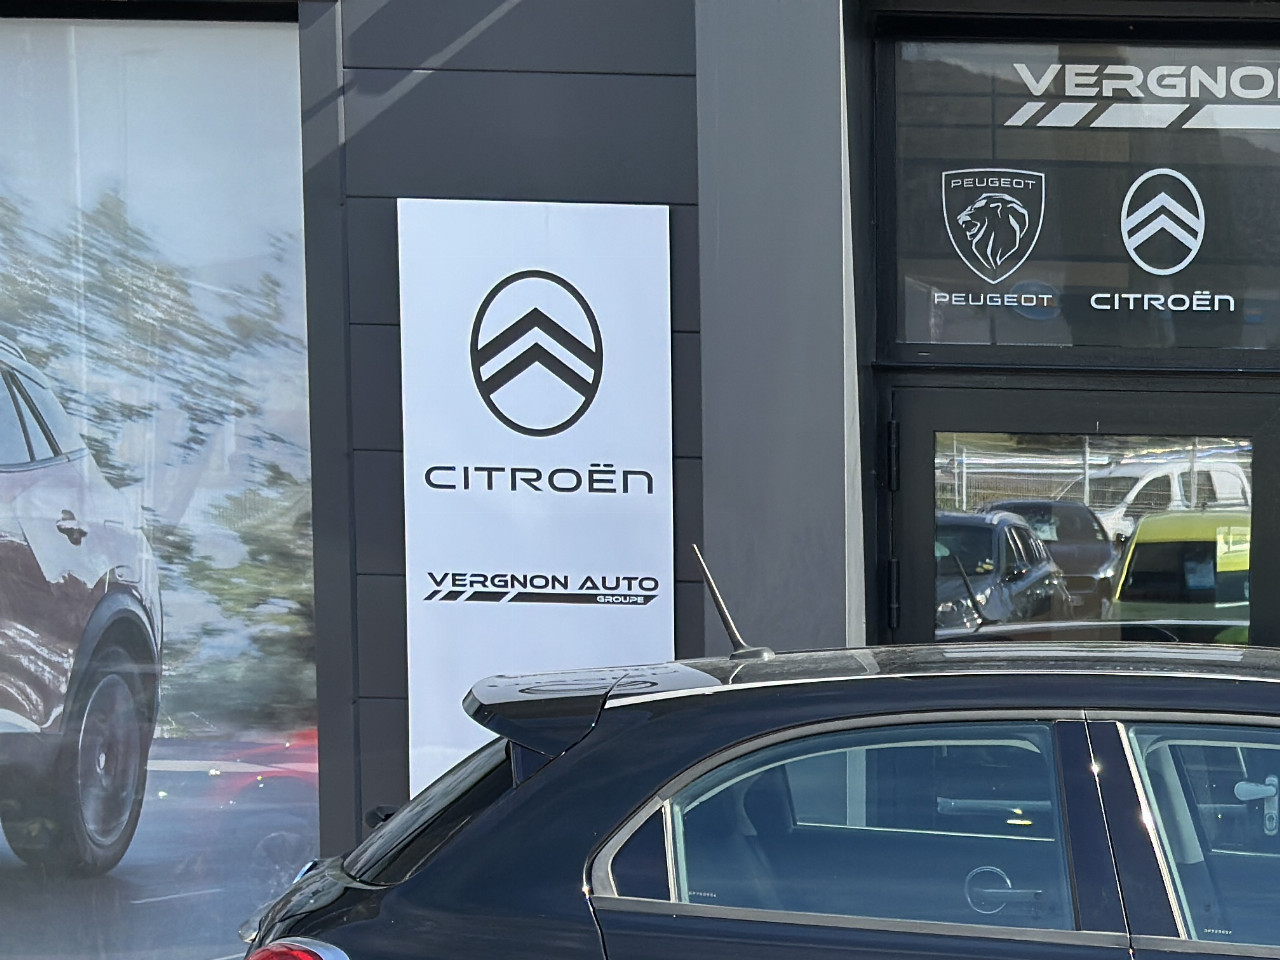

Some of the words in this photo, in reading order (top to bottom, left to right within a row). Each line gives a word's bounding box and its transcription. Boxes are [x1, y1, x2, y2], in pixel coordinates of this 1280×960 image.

[951, 178, 1035, 190] PEUGEOT
[935, 293, 1052, 306] PEUGEOT
[427, 572, 569, 590] VERGNON
[577, 576, 660, 592] AUTO
[596, 595, 645, 604] GROUPE
